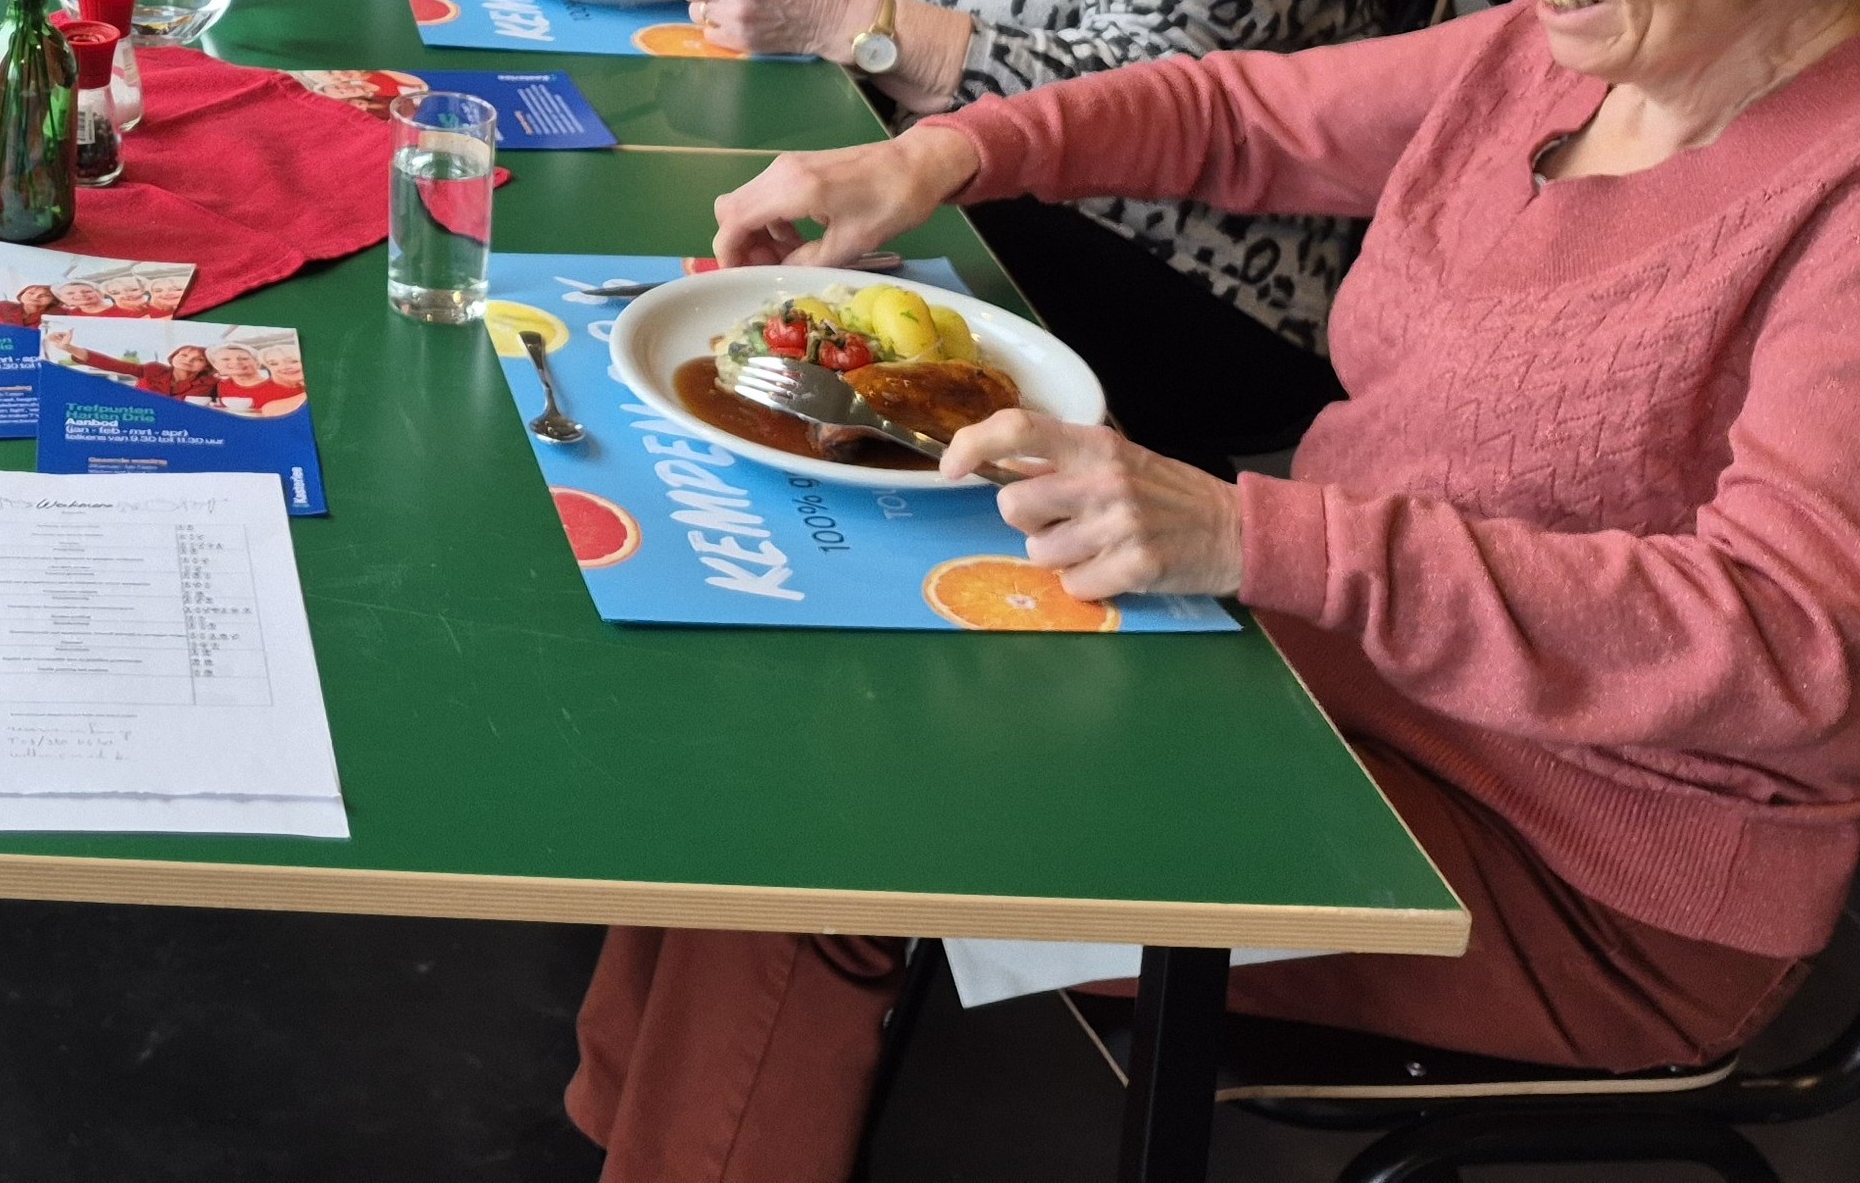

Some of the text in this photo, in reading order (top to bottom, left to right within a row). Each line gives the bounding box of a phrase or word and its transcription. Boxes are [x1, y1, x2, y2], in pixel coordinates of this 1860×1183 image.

[65, 403, 155, 416] Trefpunten
[65, 417, 119, 427] Aanbod
[99, 426, 121, 435] feb
[128, 428, 153, 436] mrt
[107, 435, 128, 443] van
[158, 435, 174, 444] tot
[791, 493, 851, 555] 100%
